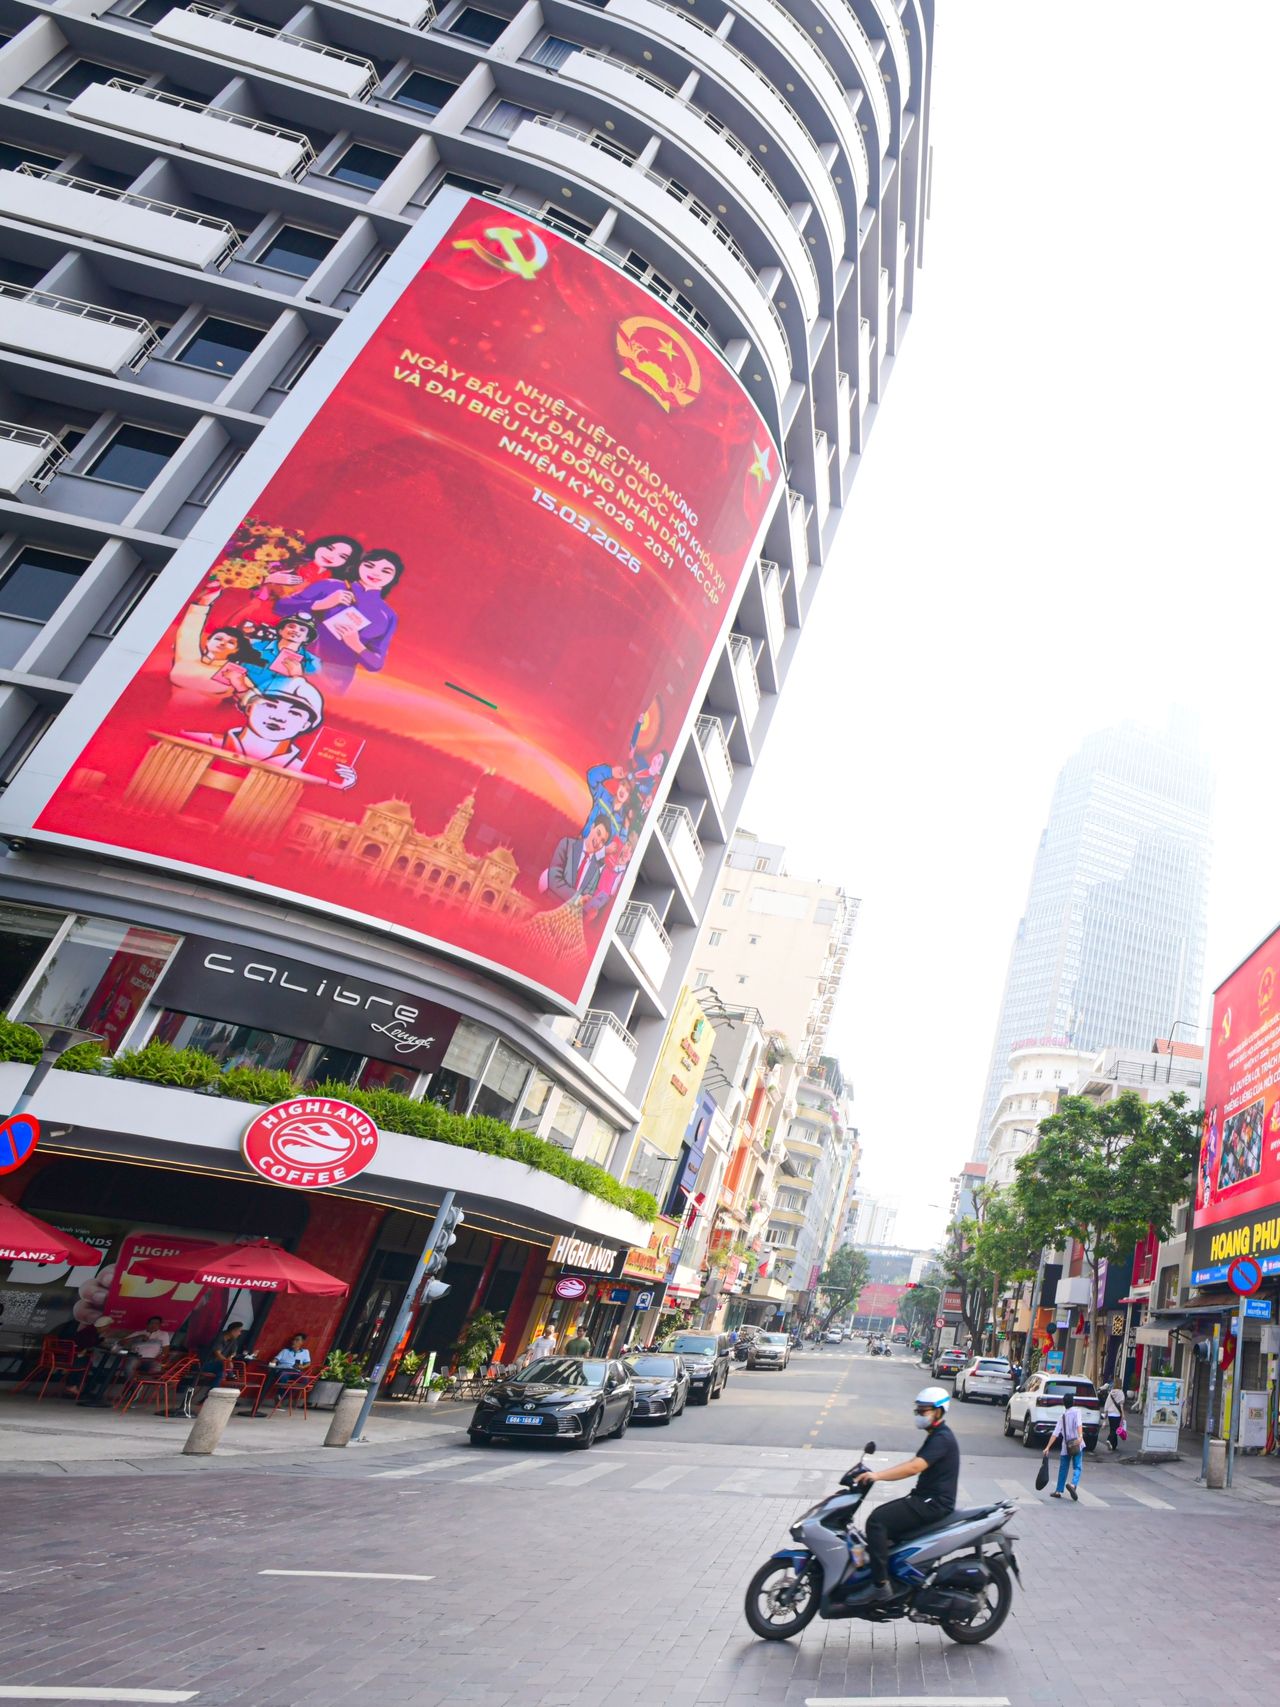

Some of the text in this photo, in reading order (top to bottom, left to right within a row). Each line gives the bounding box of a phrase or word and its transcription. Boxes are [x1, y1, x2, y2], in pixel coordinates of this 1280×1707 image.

[393, 365, 421, 387] VÀ
[425, 380, 466, 406] ĐẠI
[467, 399, 519, 431] BIỂU
[521, 426, 559, 456] HỘI
[561, 450, 615, 493] ĐỒNG
[616, 489, 660, 531] NHÂN
[659, 526, 686, 559] DÂN
[684, 554, 705, 584] CÁC
[400, 349, 726, 594] NGÀY BẦU CỬ ĐẠI BIỂU QUỐC HỘI KHÓA XVI
[514, 380, 698, 527] NHIỆT LIỆT CHÀO MỪNG
[498, 436, 674, 569] NHIỆM KỲ 2026 2031
[531, 487, 642, 574] 15.03.2026
[261, 1101, 374, 1147] HIGHLANDS
[258, 1155, 347, 1185] COFFEE
[0, 1249, 56, 1261] HLANDS
[553, 1235, 619, 1274] HIGHLANDS
[1210, 1225, 1250, 1261] HOANG
[201, 1274, 279, 1289] HIGHLANDS
